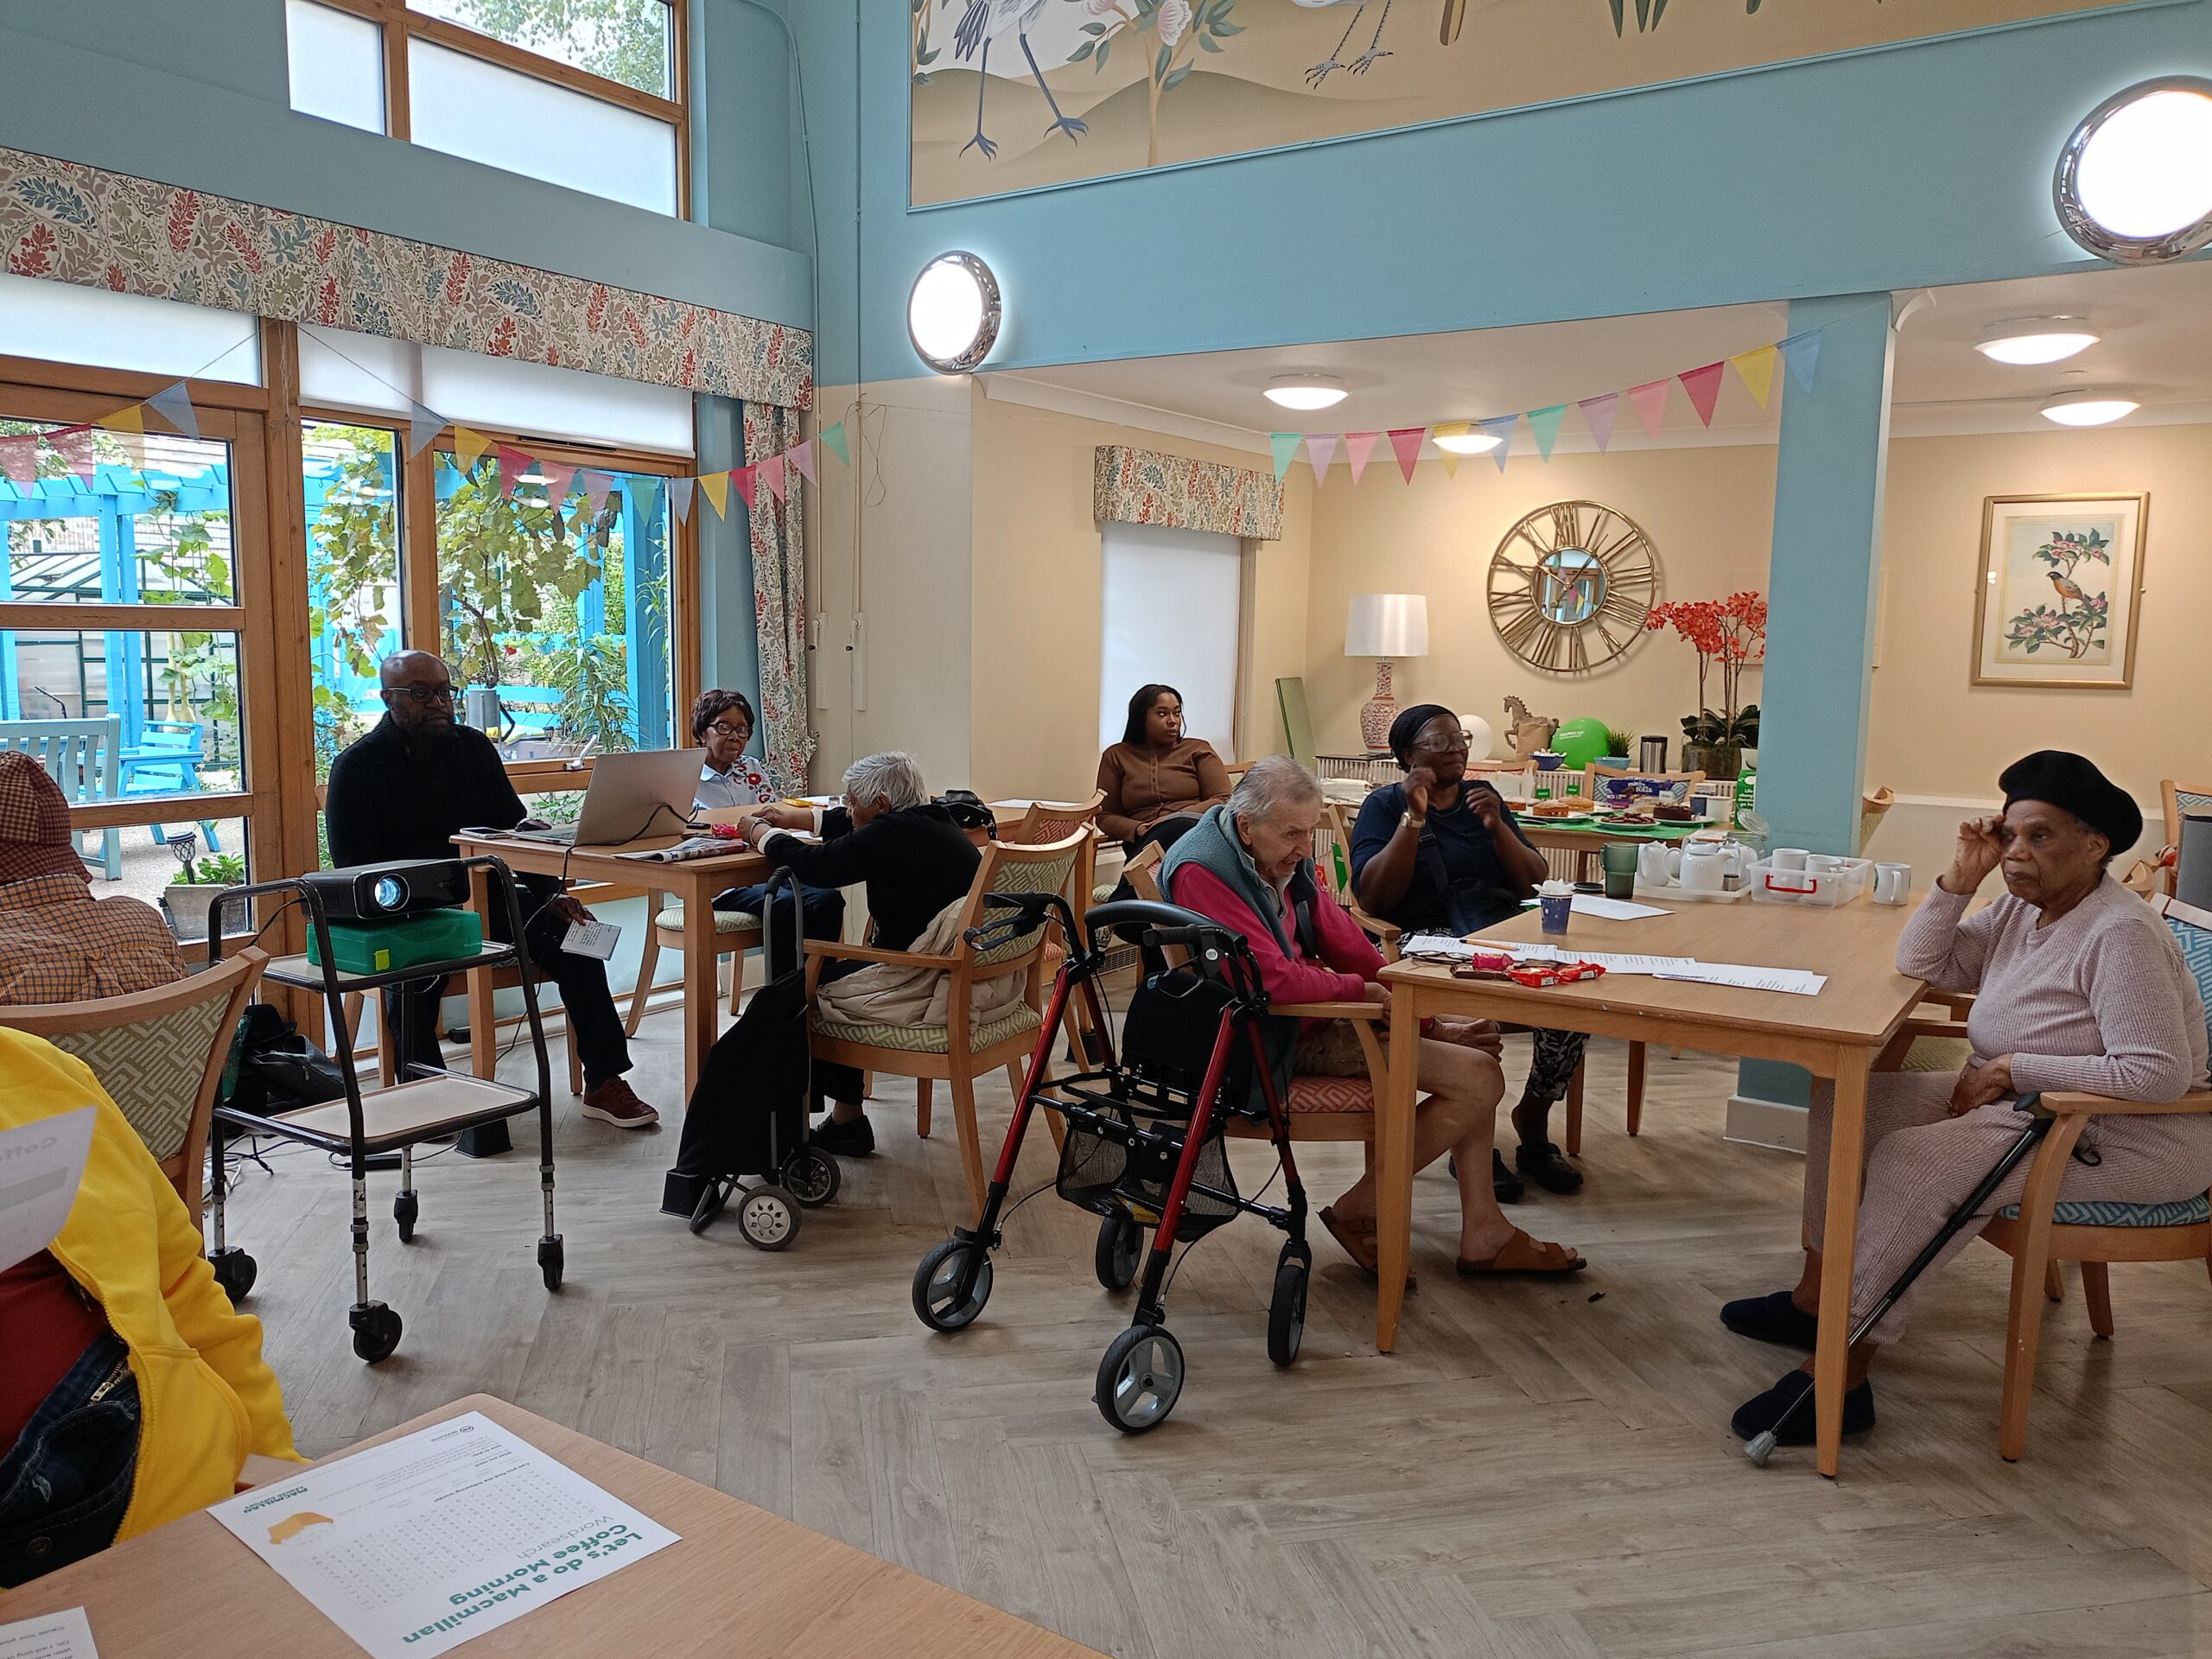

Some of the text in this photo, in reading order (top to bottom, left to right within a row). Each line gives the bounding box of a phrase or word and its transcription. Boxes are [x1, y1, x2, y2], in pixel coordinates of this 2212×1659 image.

[243, 1487, 307, 1513] MACMILLAN
[449, 1524, 626, 1605] Coffee Morning
[517, 1516, 613, 1558] Wordsearch
[403, 1532, 642, 1642] Let's do a Macmillan
